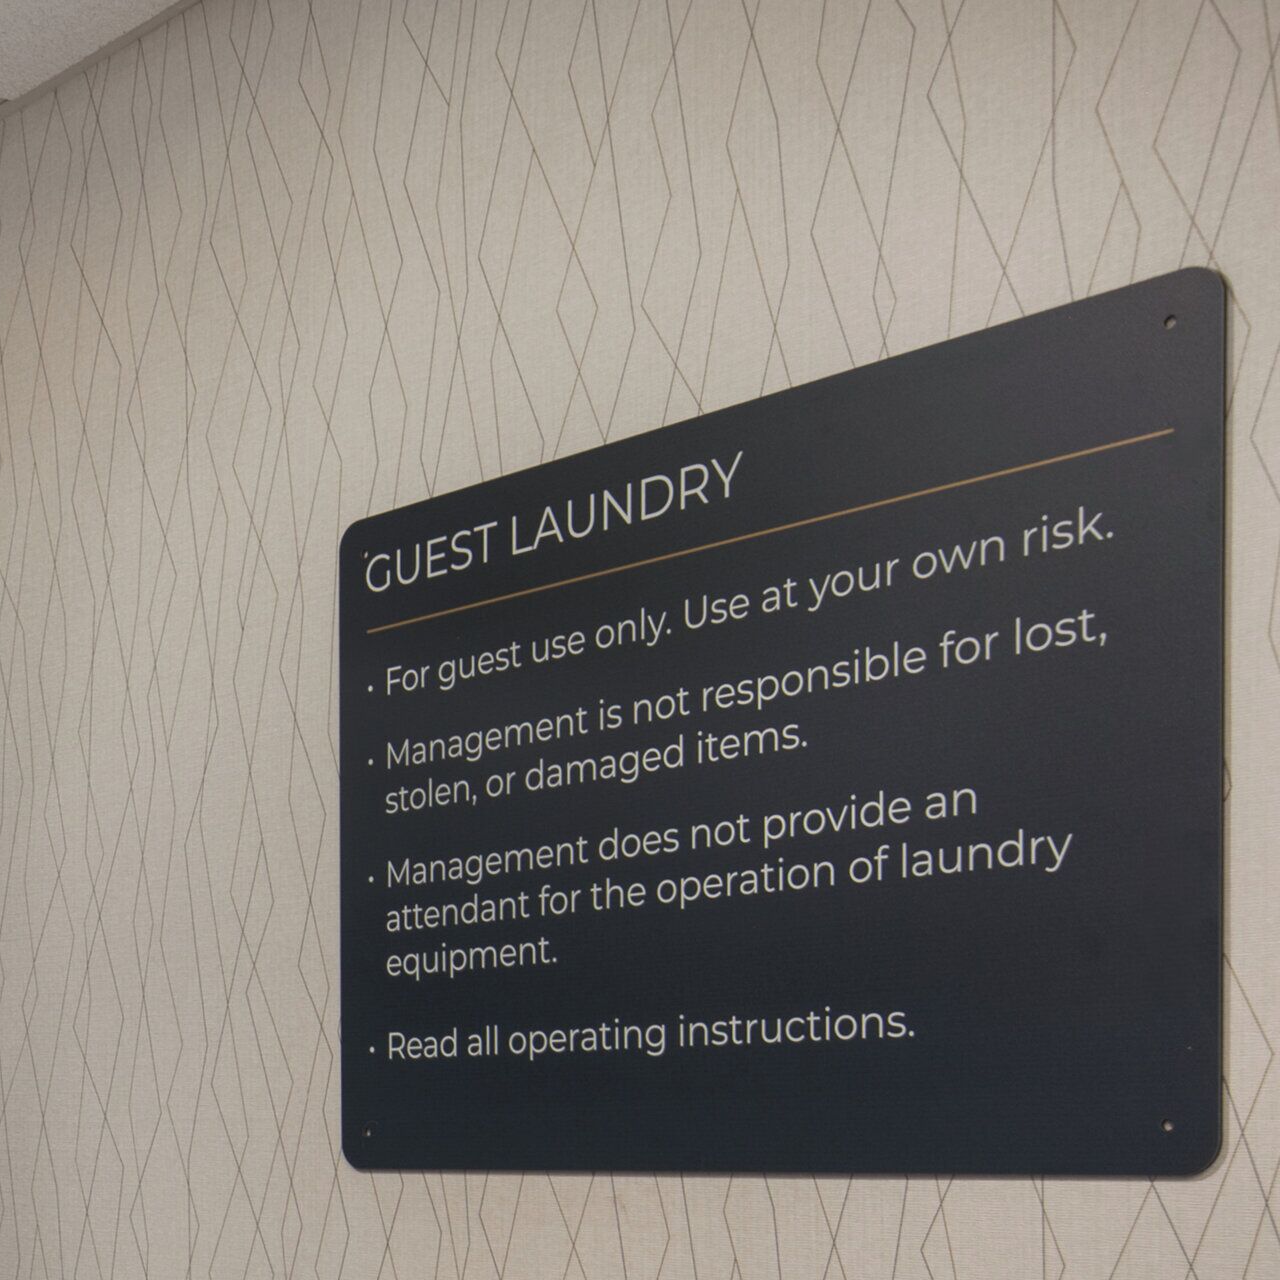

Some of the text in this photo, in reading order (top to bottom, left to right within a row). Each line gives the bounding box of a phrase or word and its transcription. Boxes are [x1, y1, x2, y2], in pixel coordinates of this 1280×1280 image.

[366, 451, 743, 592] GUEST LAUNDRY
[386, 506, 1115, 695] For guest use only. Use at your own risk.
[387, 609, 1108, 770] Management is not responsible for lost,
[385, 723, 808, 815] stolen, or damaged items.
[386, 828, 1073, 932] attendant for the operation of laundry
[387, 788, 978, 888] Management does not provide an
[386, 936, 558, 981] equipment.
[387, 1006, 915, 1060] Read all operating instructions.
